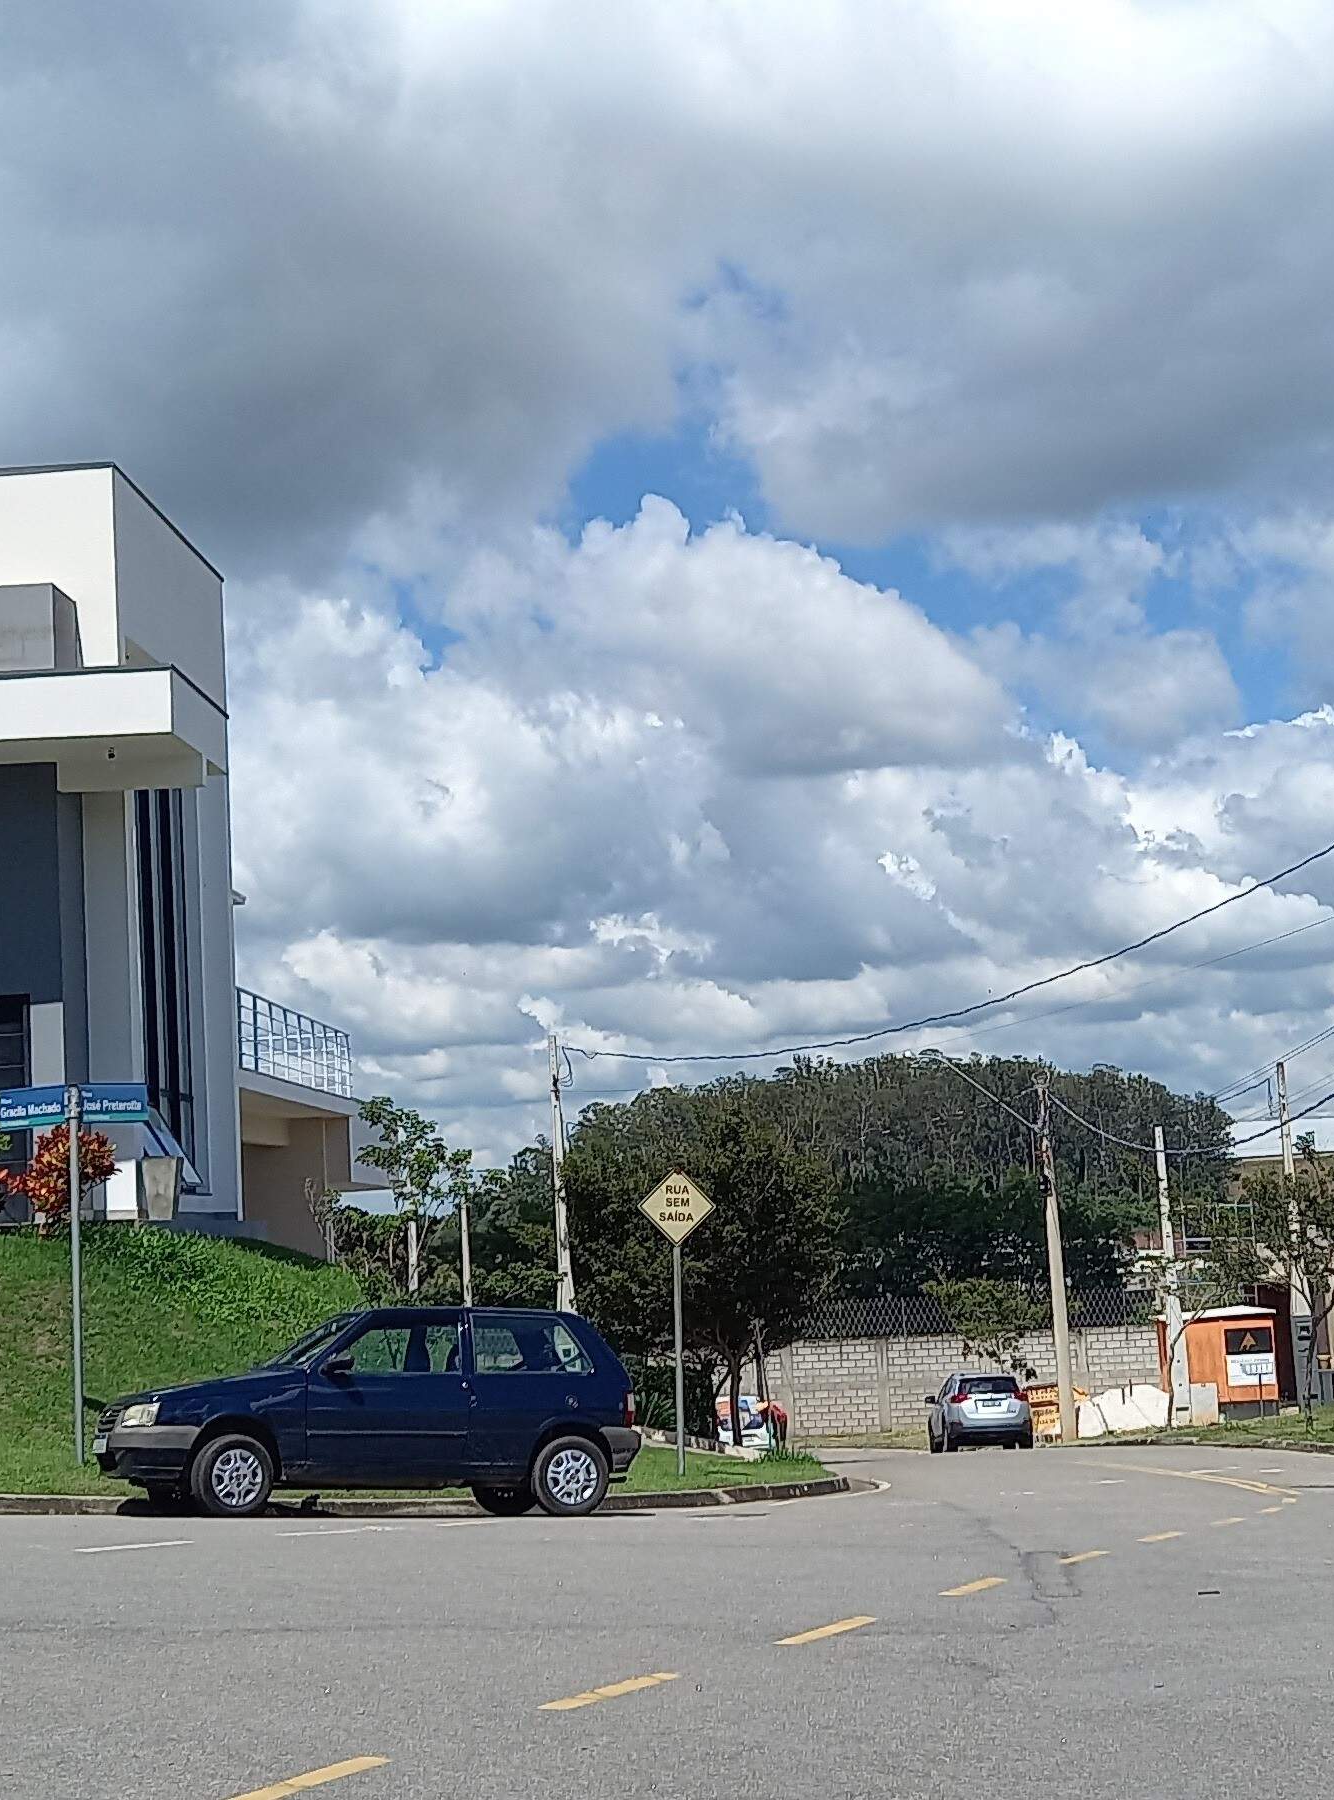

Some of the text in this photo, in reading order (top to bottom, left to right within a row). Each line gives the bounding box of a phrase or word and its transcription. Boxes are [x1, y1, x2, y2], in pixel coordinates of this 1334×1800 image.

[27, 1102, 62, 1116] Machado
[82, 1099, 102, 1112] José
[665, 1184, 690, 1195] RUA
[665, 1197, 690, 1208] SEM
[659, 1210, 694, 1222] SAÍDA
